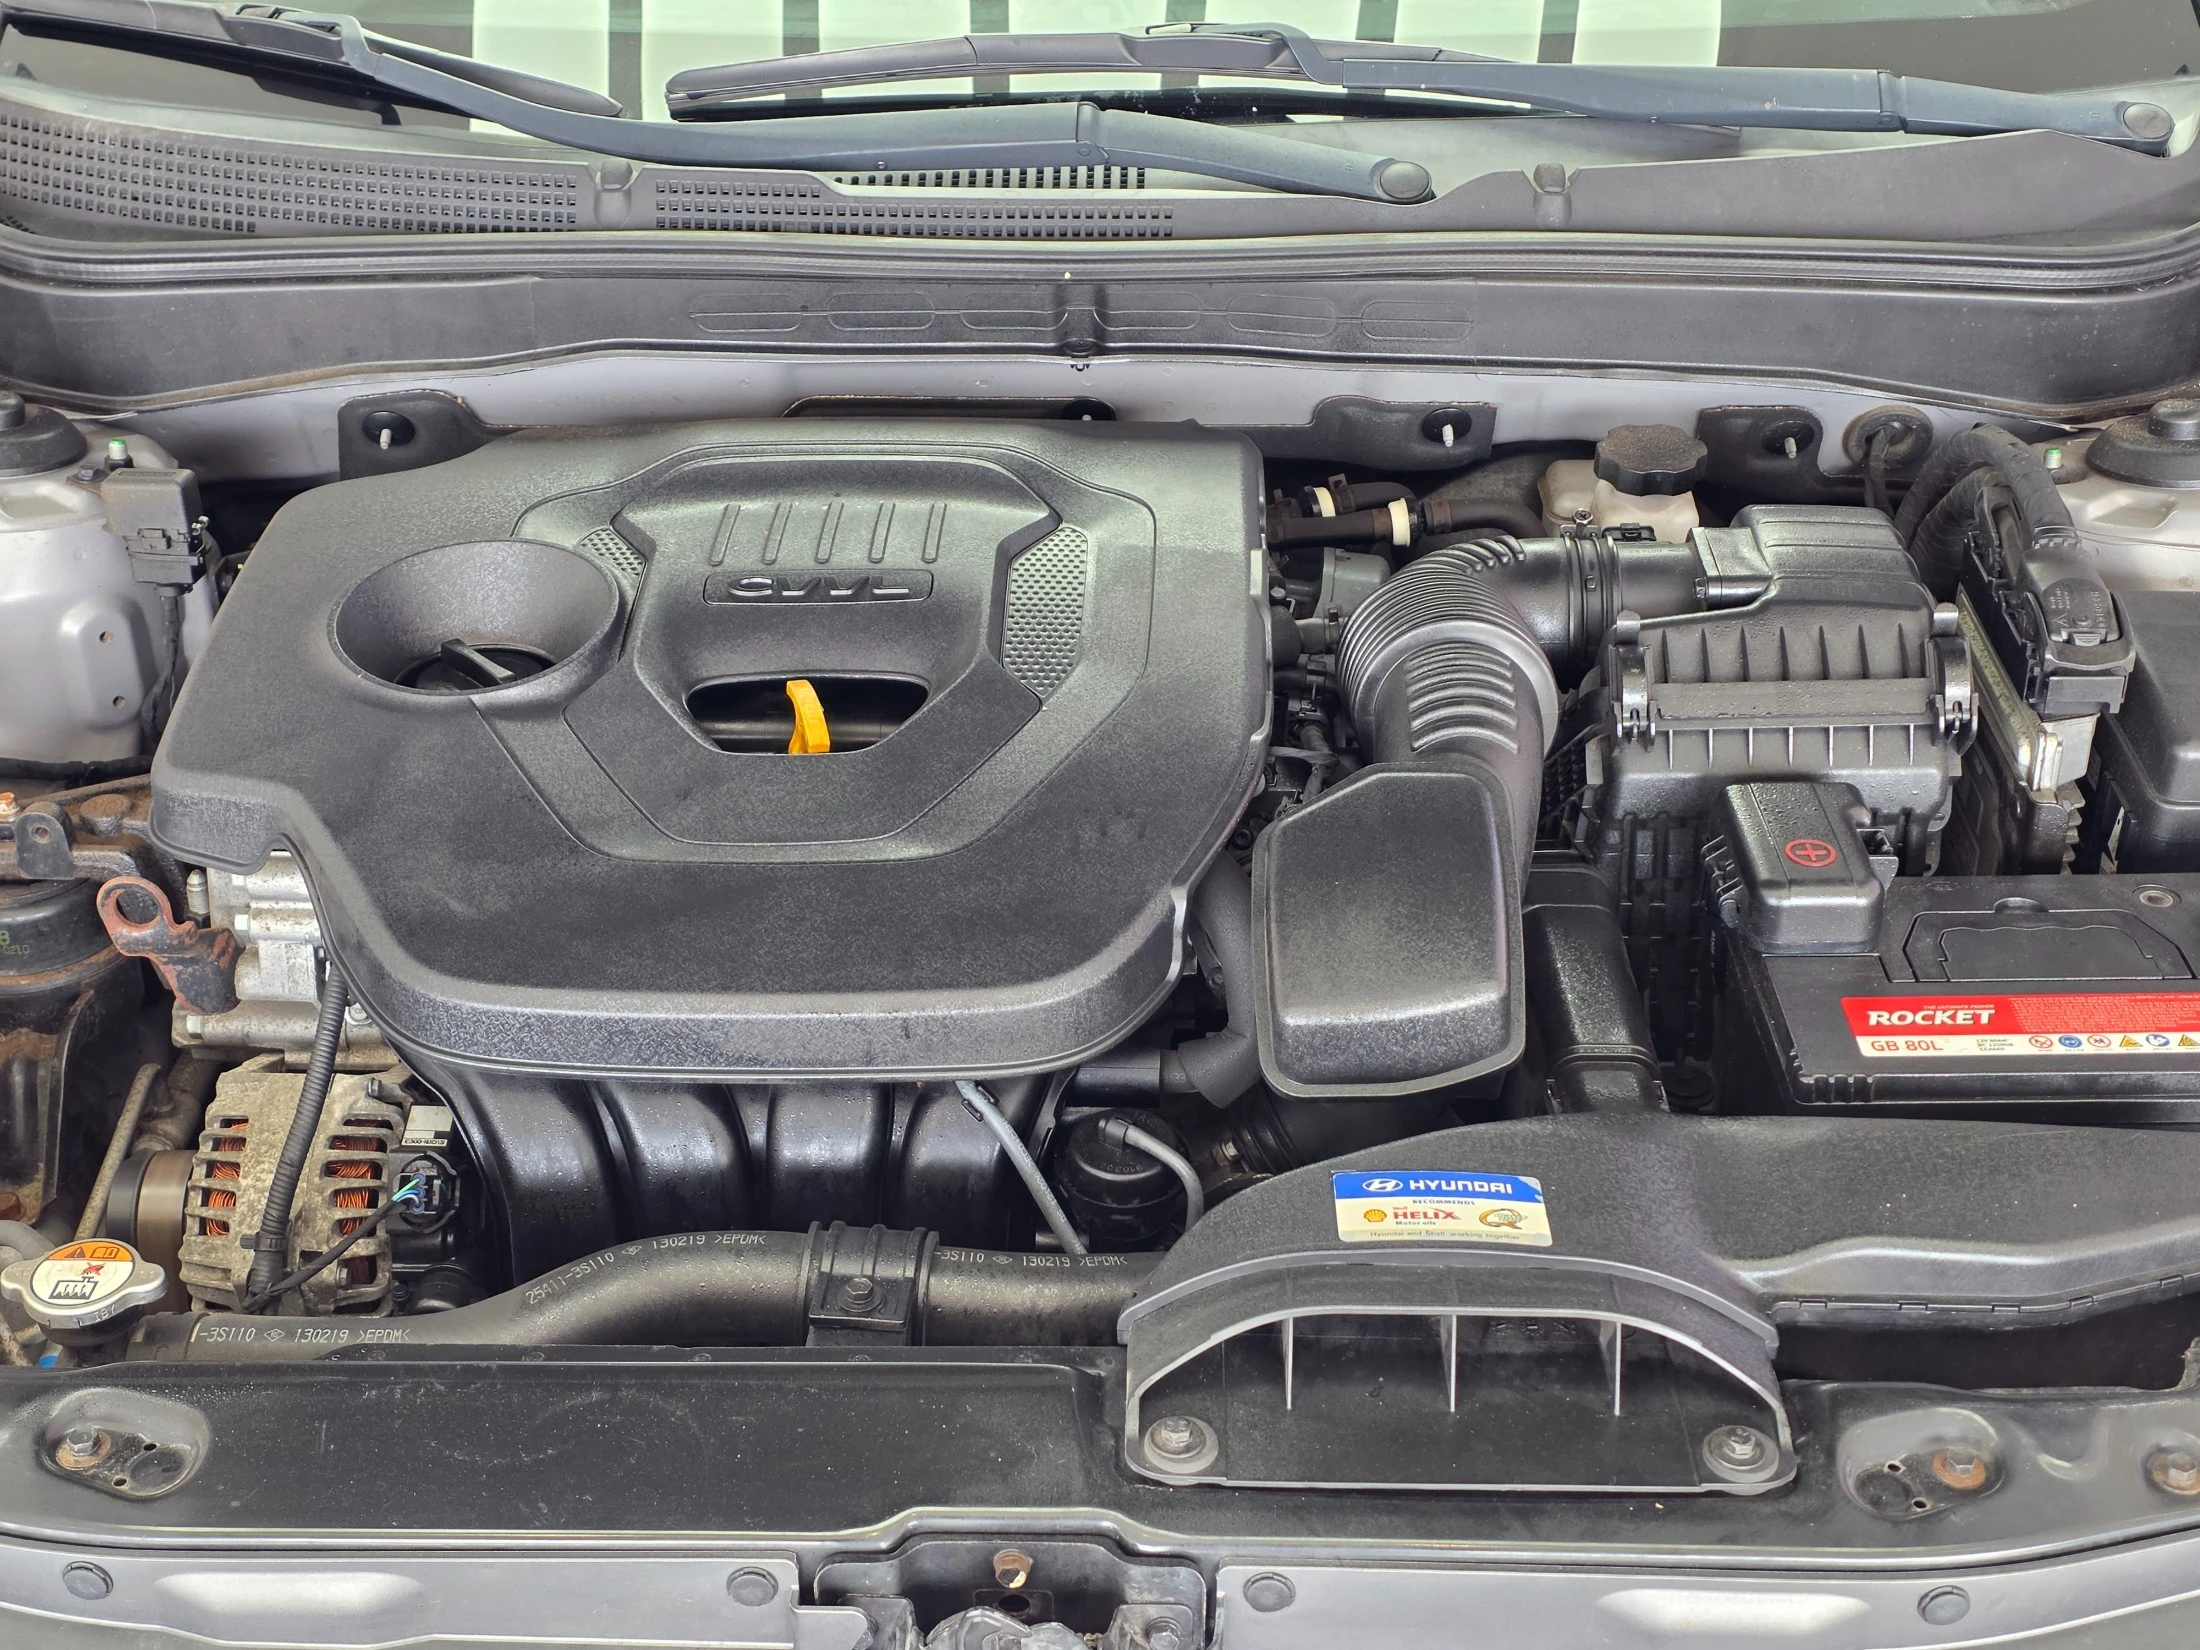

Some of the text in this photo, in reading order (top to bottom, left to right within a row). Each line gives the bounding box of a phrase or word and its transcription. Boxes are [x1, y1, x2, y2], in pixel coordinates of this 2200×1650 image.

[728, 576, 910, 597] CVVL
[1866, 1009, 1996, 1026] ROCKET
[1871, 1039, 1944, 1052] GB 80L
[1409, 1179, 1513, 1195] HYUNDAI
[1393, 1209, 1459, 1220] HELIX
[1370, 1231, 1404, 1239] Hyundai
[526, 1252, 615, 1305] 25411-3S110
[652, 1234, 706, 1250] 130219
[1022, 1256, 1071, 1268] 130219
[293, 1328, 349, 1343] 130219
